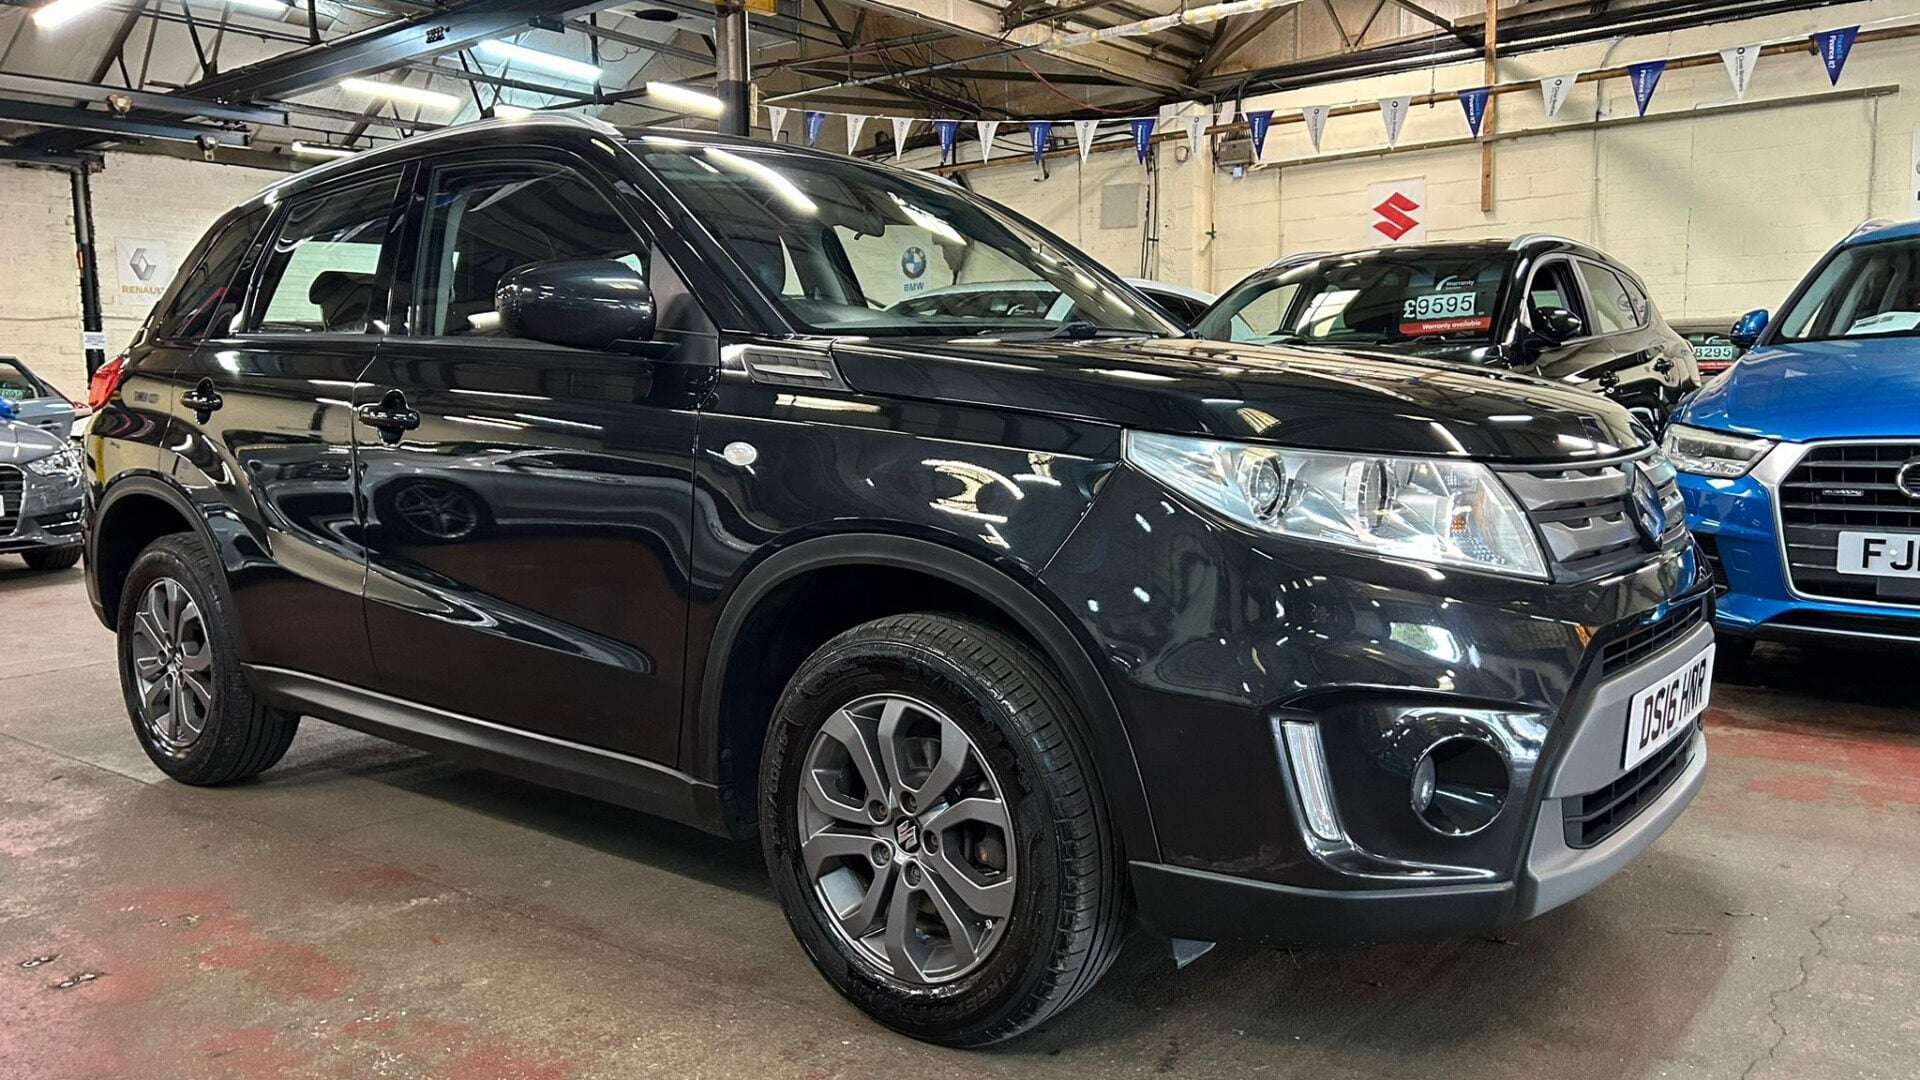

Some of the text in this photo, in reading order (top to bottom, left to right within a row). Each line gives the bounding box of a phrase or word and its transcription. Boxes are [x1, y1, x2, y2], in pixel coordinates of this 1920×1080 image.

[903, 282, 925, 292] BMW
[1403, 295, 1473, 318] £9595
[1861, 538, 1920, 572] FJ
[1639, 657, 1707, 751] DS16 HNR
